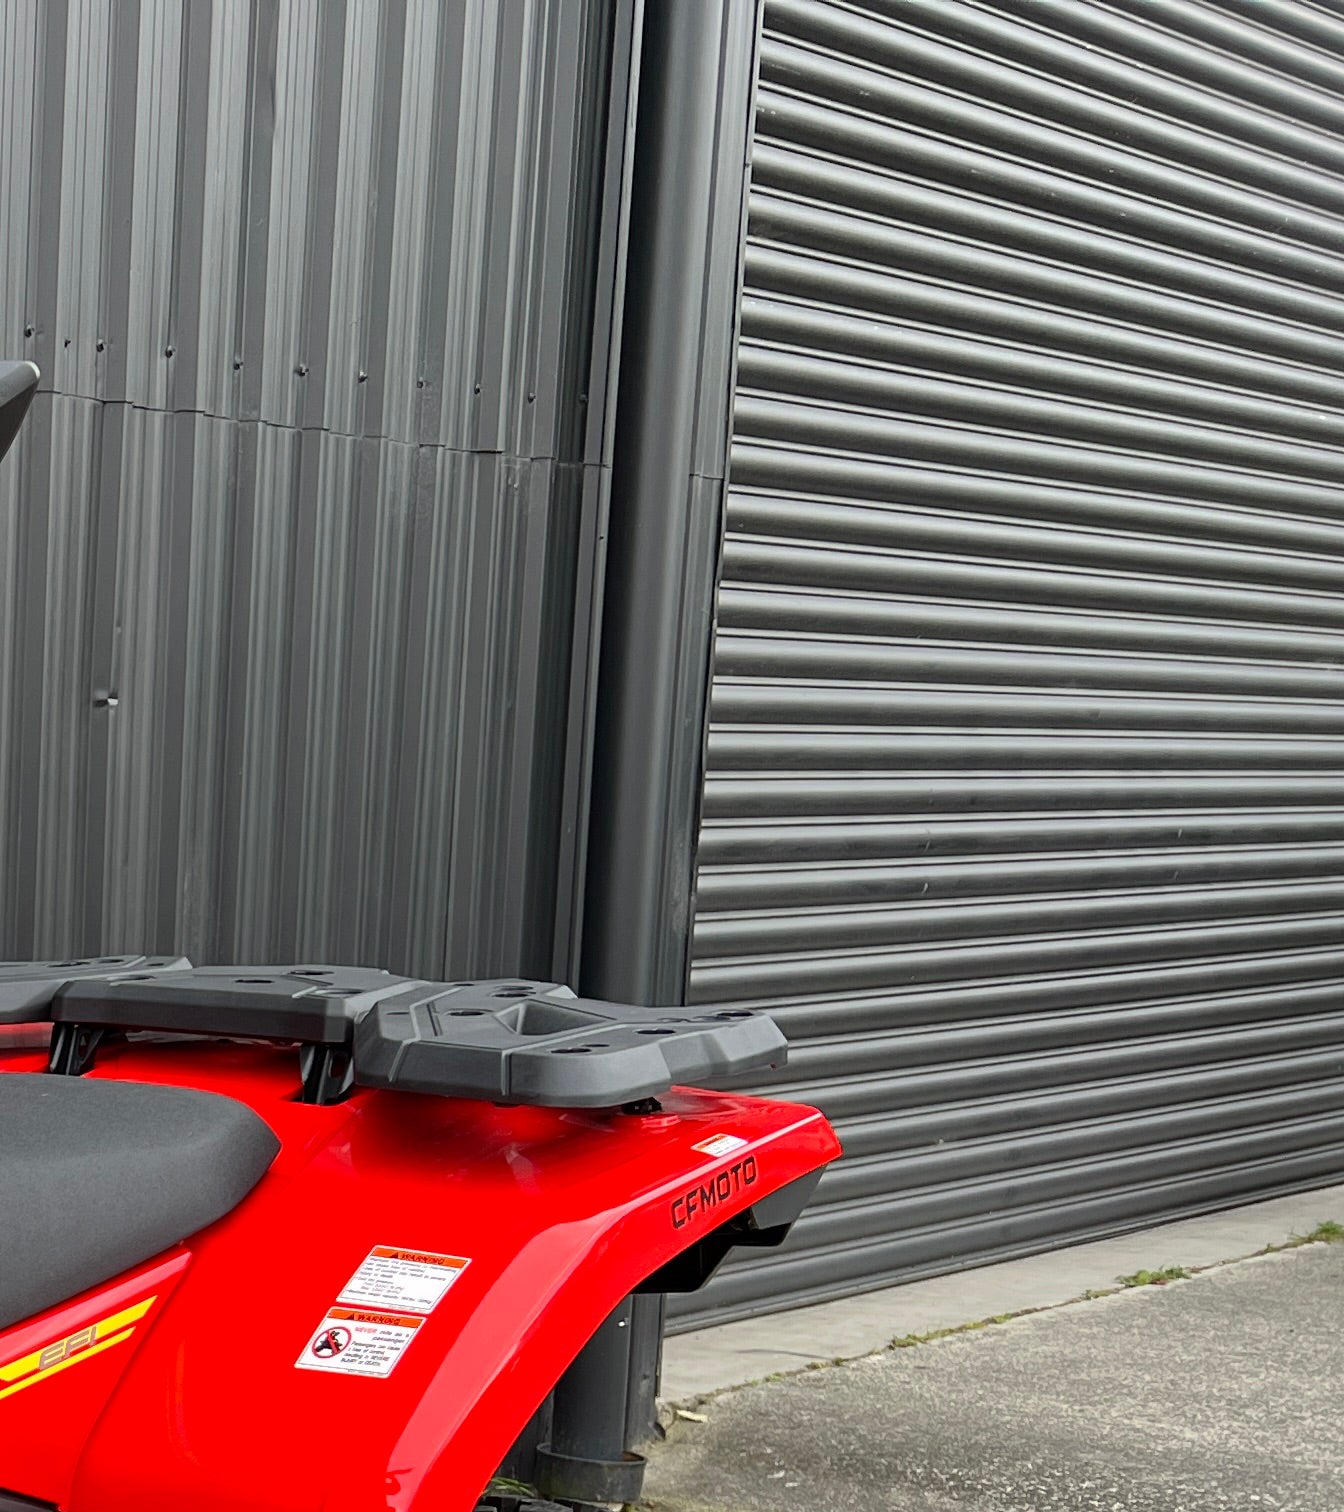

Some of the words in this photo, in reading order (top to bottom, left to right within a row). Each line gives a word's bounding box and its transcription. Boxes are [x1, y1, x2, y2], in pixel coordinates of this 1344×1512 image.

[671, 1154, 757, 1230] CFMOTO
[401, 1252, 445, 1265] WARNING
[357, 1313, 401, 1326] WARNING
[39, 1325, 97, 1371] EFI
